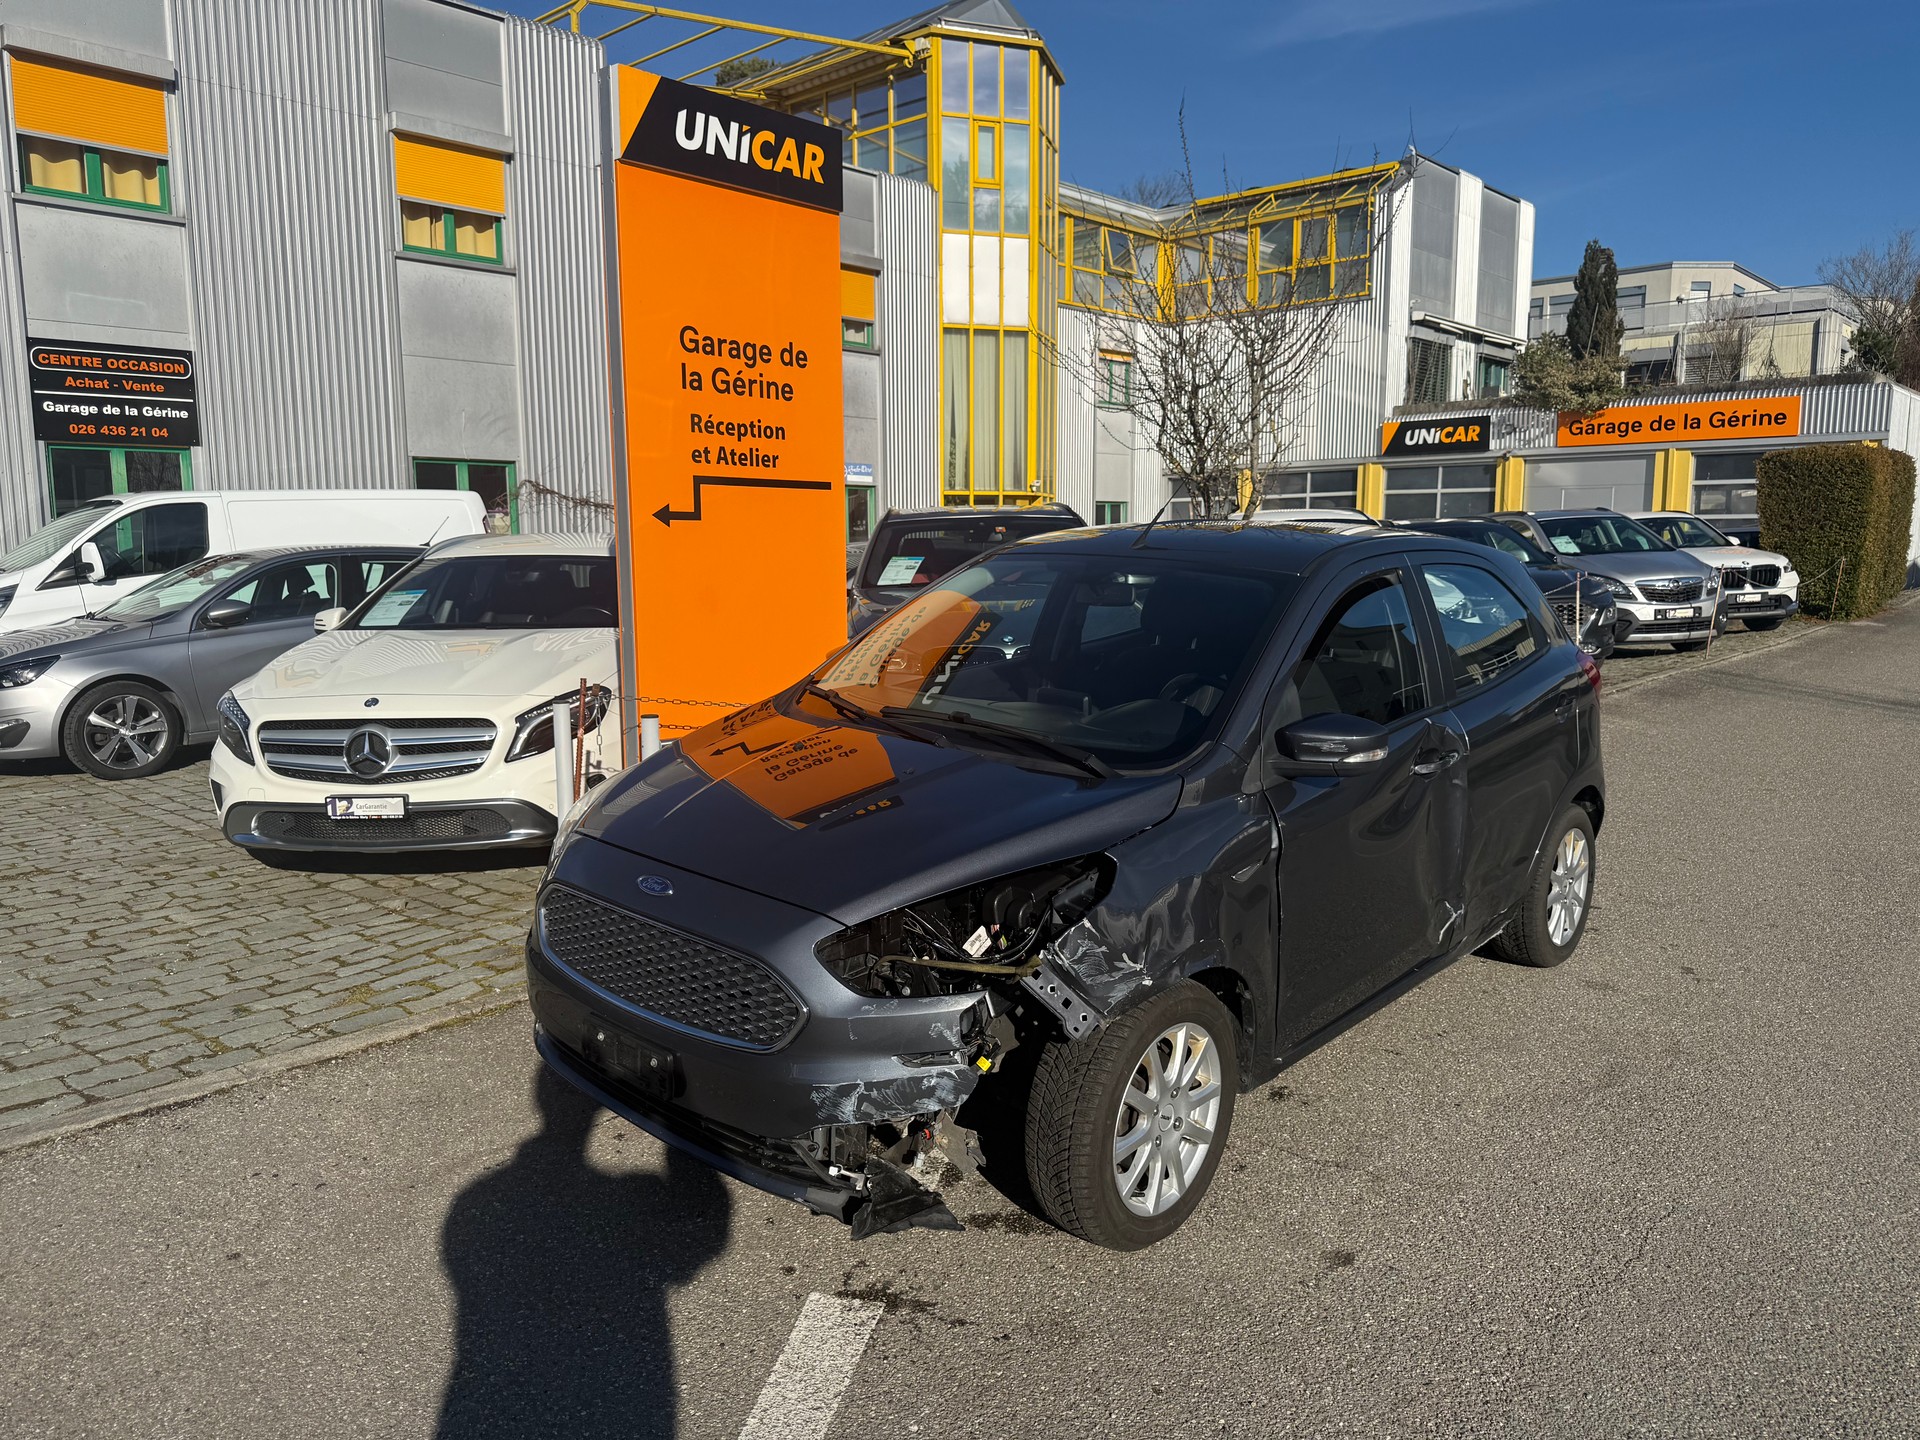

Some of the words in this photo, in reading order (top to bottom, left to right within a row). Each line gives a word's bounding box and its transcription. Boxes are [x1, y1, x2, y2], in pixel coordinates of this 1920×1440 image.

[679, 325, 772, 369] Garage
[780, 342, 808, 369] de
[38, 353, 102, 368] CENTRE
[107, 358, 185, 374] OCCASION
[65, 376, 109, 389] Achat
[122, 380, 165, 393] Vente
[681, 363, 702, 391] la
[712, 366, 794, 402] Gérine
[42, 401, 99, 416] Garage
[103, 404, 121, 415] de
[125, 405, 138, 417] la
[142, 406, 189, 419] Gérine
[69, 424, 96, 435] 026
[100, 425, 127, 436] 436
[131, 426, 147, 437] 21
[151, 427, 169, 438] 04
[690, 413, 786, 442] Réception
[1569, 419, 1643, 438] Garage
[1650, 415, 1675, 432] de
[1683, 414, 1701, 430] la
[1709, 409, 1788, 429] Gérine
[691, 446, 711, 464] et
[716, 446, 779, 468] Atelier
